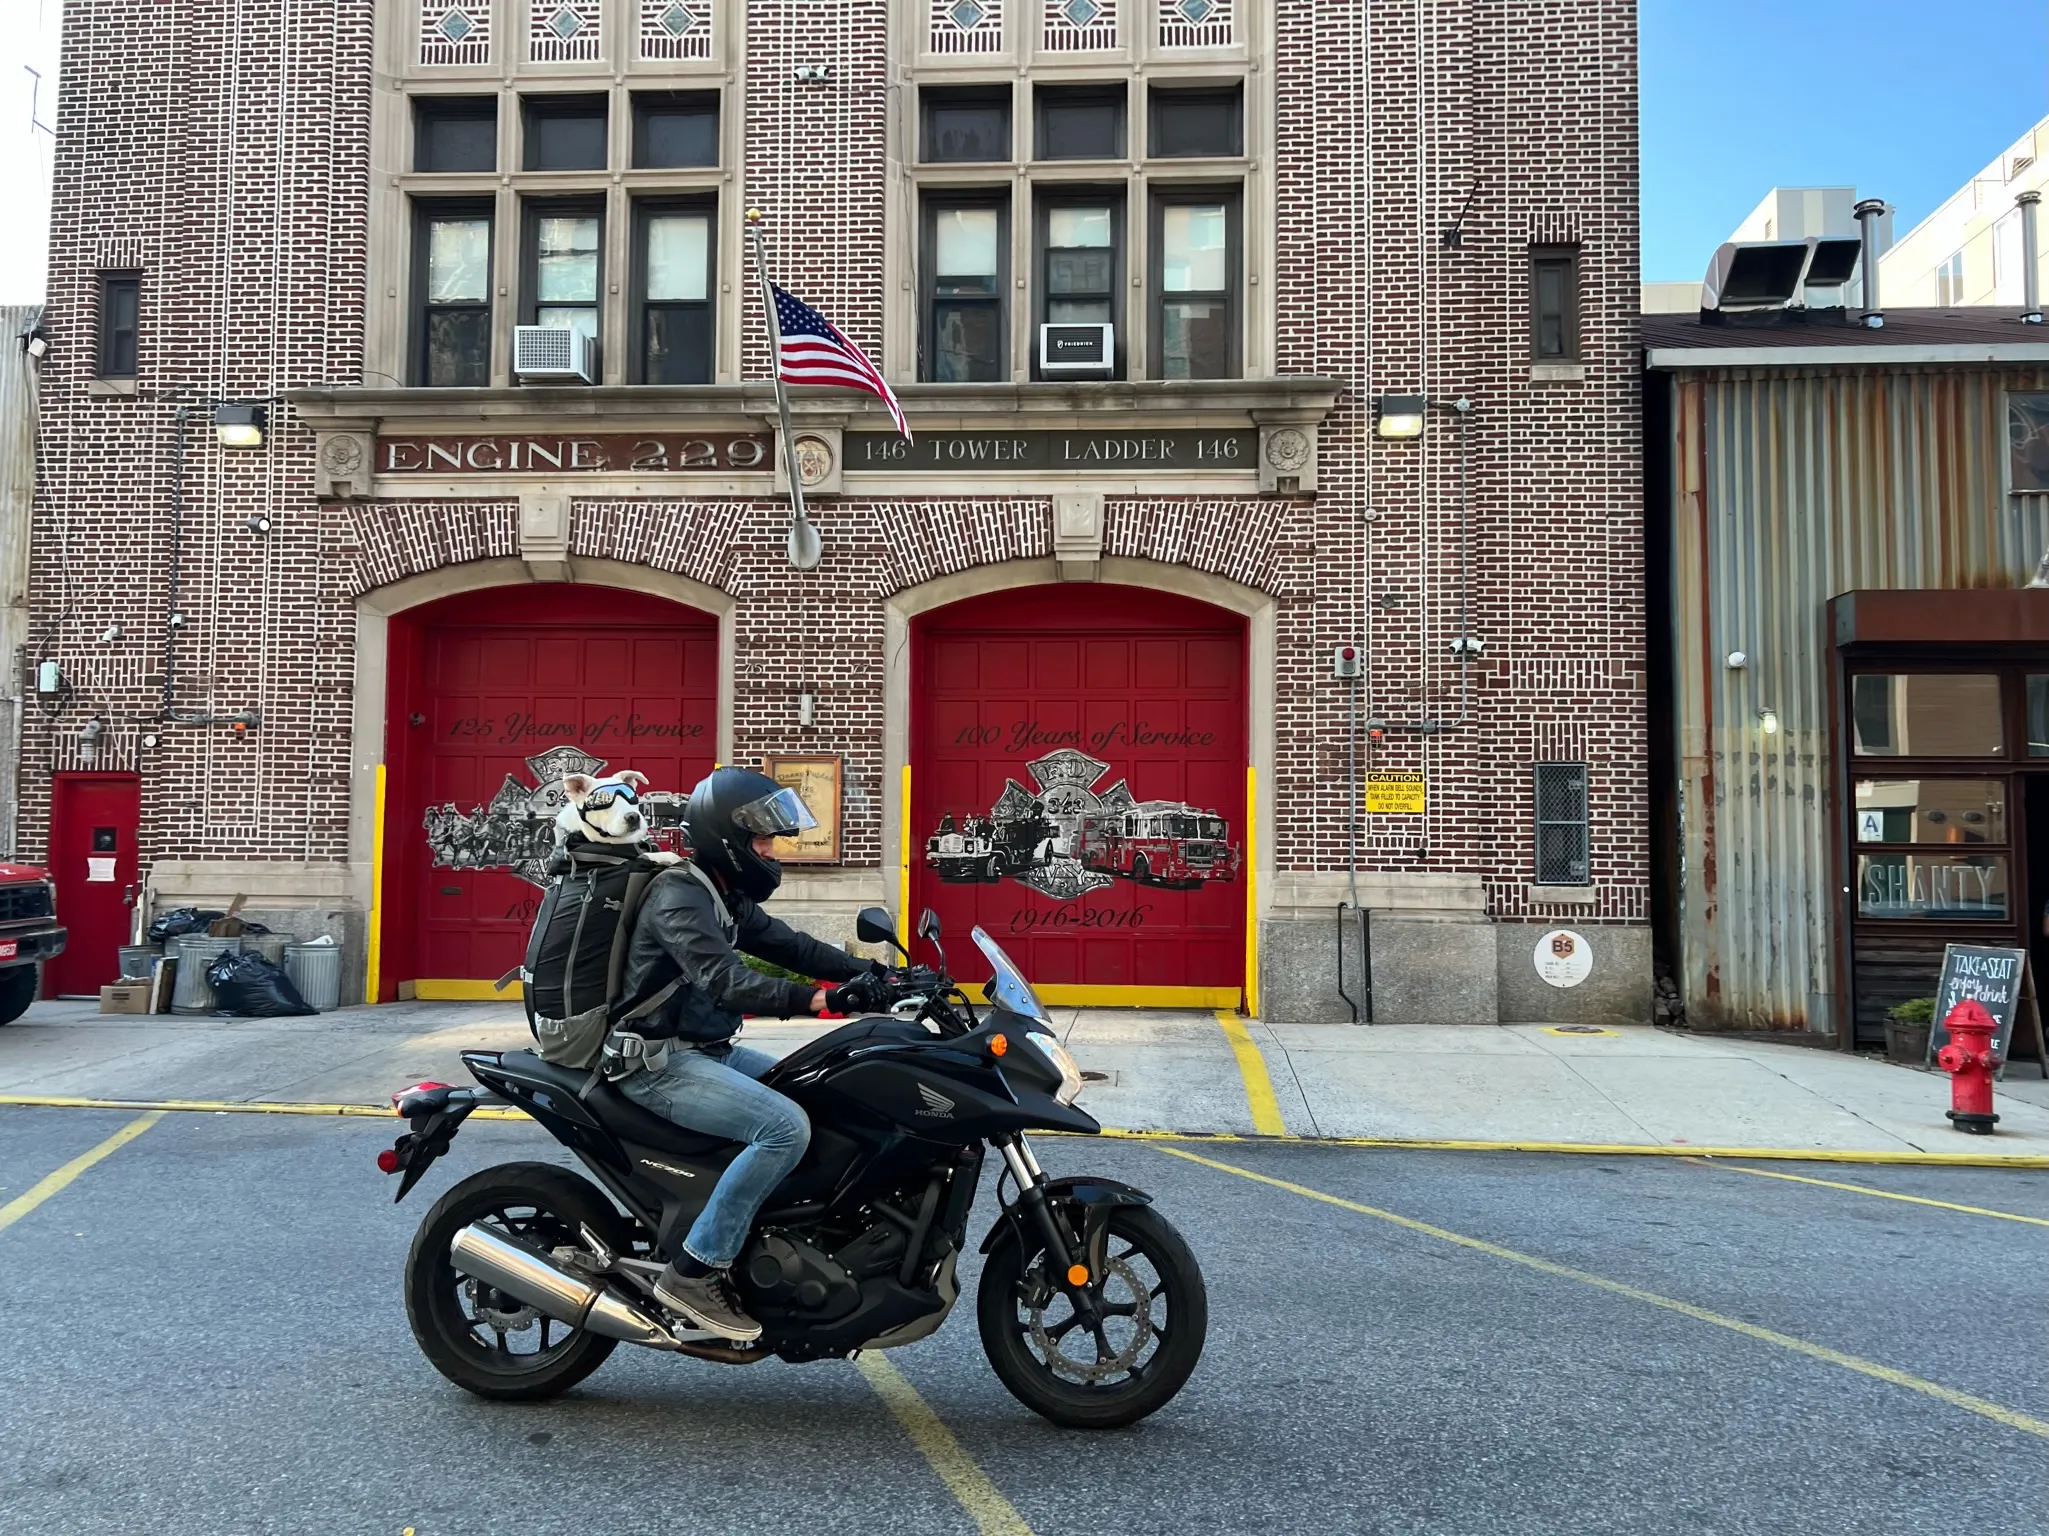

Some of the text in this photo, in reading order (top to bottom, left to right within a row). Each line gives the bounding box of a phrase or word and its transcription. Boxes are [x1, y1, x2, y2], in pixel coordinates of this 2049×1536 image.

[386, 440, 765, 471] ENGINE 229
[864, 438, 1239, 461] 146 TOWER LADDER 146
[449, 712, 704, 745] 125 Years of Service
[954, 720, 1216, 753] 100 Years of Service
[1370, 774, 1420, 782] CAUTION
[1863, 815, 1878, 833] A
[1868, 864, 1997, 910] SHANTY
[505, 899, 540, 926] 18
[1010, 903, 1153, 933] 1916-2016
[1552, 940, 1573, 952] B5
[1953, 954, 1982, 976] TAKE
[1987, 957, 2016, 979] SEAT
[1979, 985, 2010, 1004] drink
[914, 1109, 955, 1119] HONDA
